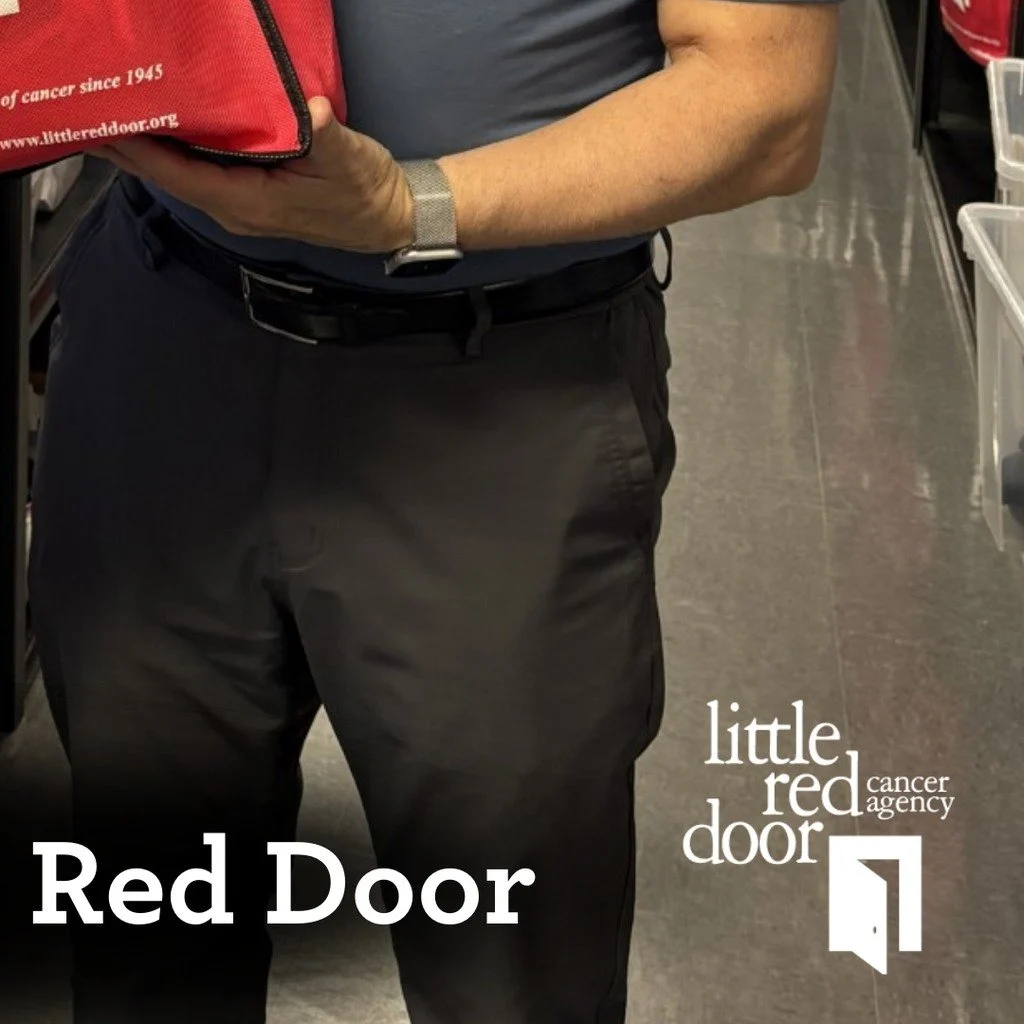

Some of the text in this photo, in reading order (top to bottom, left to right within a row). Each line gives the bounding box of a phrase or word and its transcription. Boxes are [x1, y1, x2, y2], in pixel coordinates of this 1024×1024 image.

[0, 90, 20, 110] of
[21, 83, 76, 105] cancer
[79, 74, 121, 95] since
[126, 63, 164, 87] 1945
